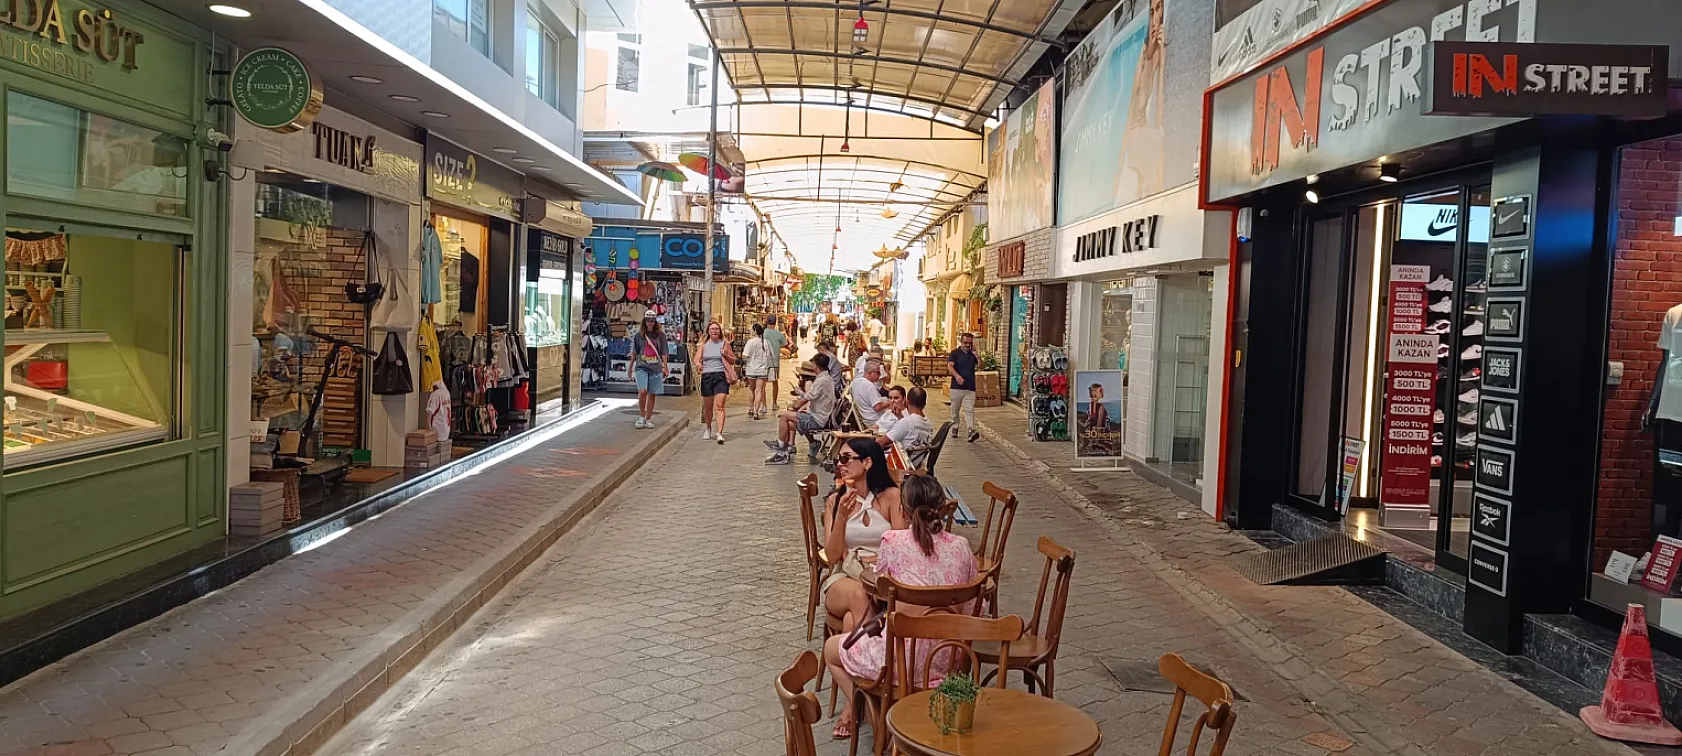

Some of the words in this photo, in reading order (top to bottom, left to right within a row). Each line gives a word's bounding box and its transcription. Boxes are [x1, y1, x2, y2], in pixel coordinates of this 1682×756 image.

[72, 8, 144, 70] SÜT
[241, 62, 251, 76] ICE
[252, 54, 280, 65] CREAM
[1453, 53, 1518, 98] IN
[1523, 63, 1651, 95] STREET
[236, 83, 251, 112] GELATO
[1251, 46, 1324, 175] IN
[434, 152, 464, 191] SIZE
[1435, 208, 1458, 223] NIK
[1072, 226, 1118, 262] JIMMY
[1122, 215, 1160, 253] KEY
[1395, 339, 1434, 348] ANINDA
[1397, 349, 1431, 358] KAZAN
[1488, 366, 1510, 377] JONES
[1397, 380, 1414, 388] 500
[1417, 381, 1428, 389] TL
[1393, 405, 1415, 413] 1000
[1417, 406, 1428, 414] TL
[1388, 443, 1428, 455] İNDİRİM
[1481, 458, 1504, 477] VANS
[1479, 503, 1501, 517] Reebok
